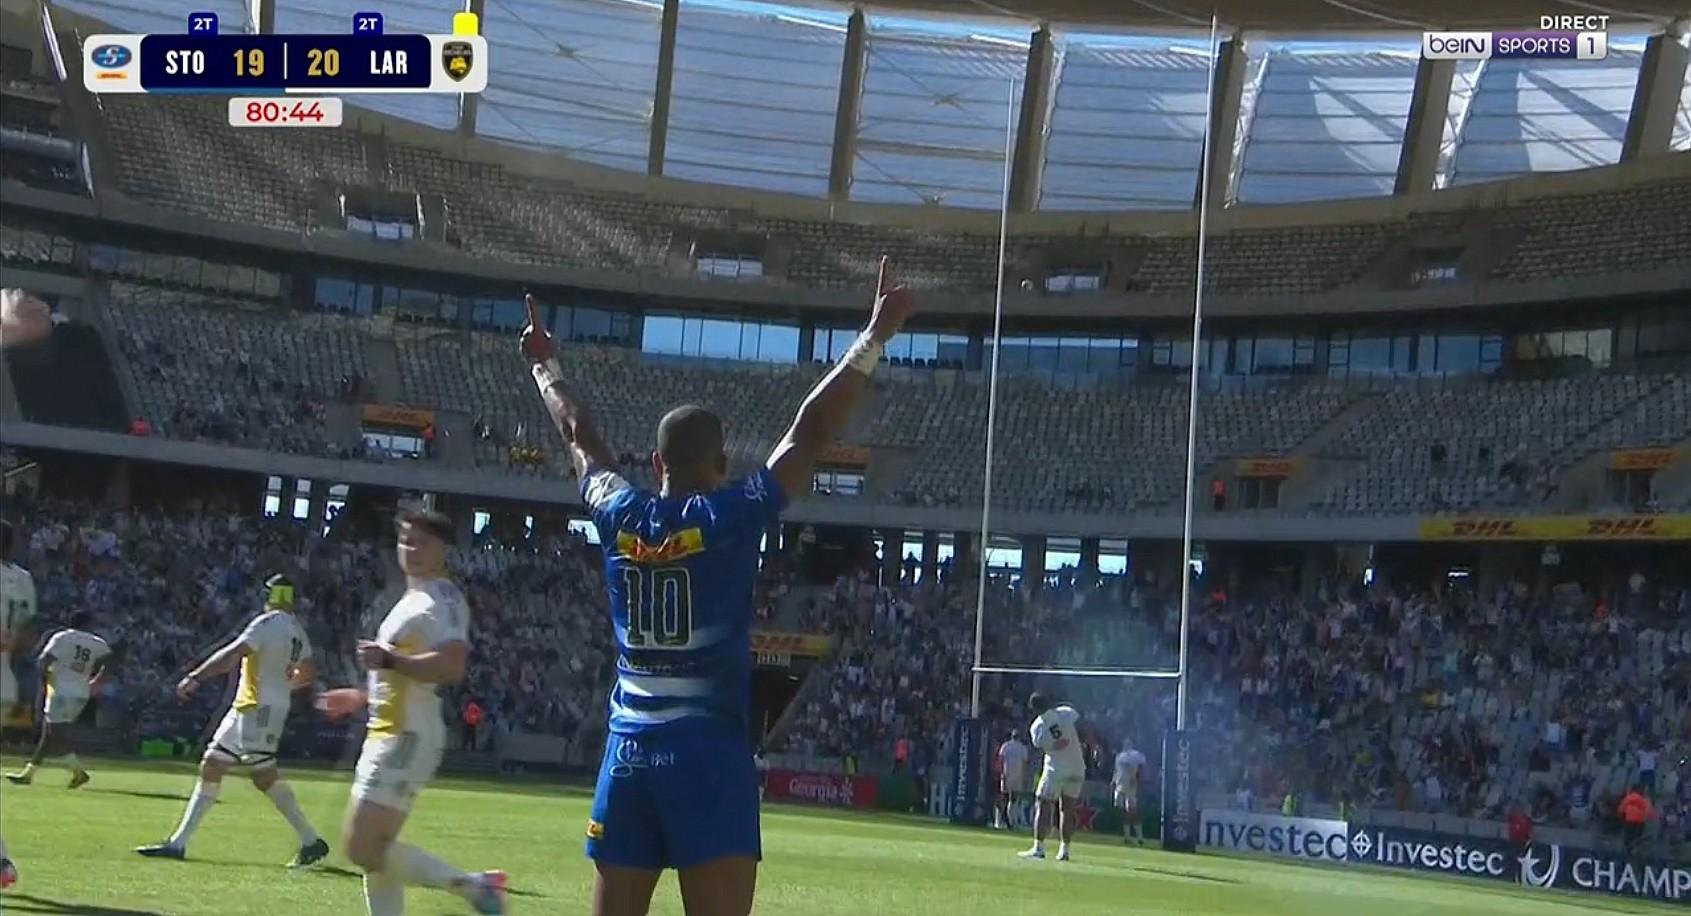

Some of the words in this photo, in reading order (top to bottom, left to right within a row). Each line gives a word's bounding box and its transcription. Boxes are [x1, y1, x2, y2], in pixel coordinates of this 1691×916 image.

[1453, 520, 1518, 536] DHL
[1587, 518, 1657, 535] DHL
[623, 566, 693, 650] 10
[1048, 722, 1063, 740] 5
[789, 778, 839, 801] Georgia
[1173, 739, 1190, 823] Investec
[1205, 819, 1347, 860] nvestec
[1377, 831, 1504, 875] Investec
[1572, 857, 1691, 899] CHAMP
